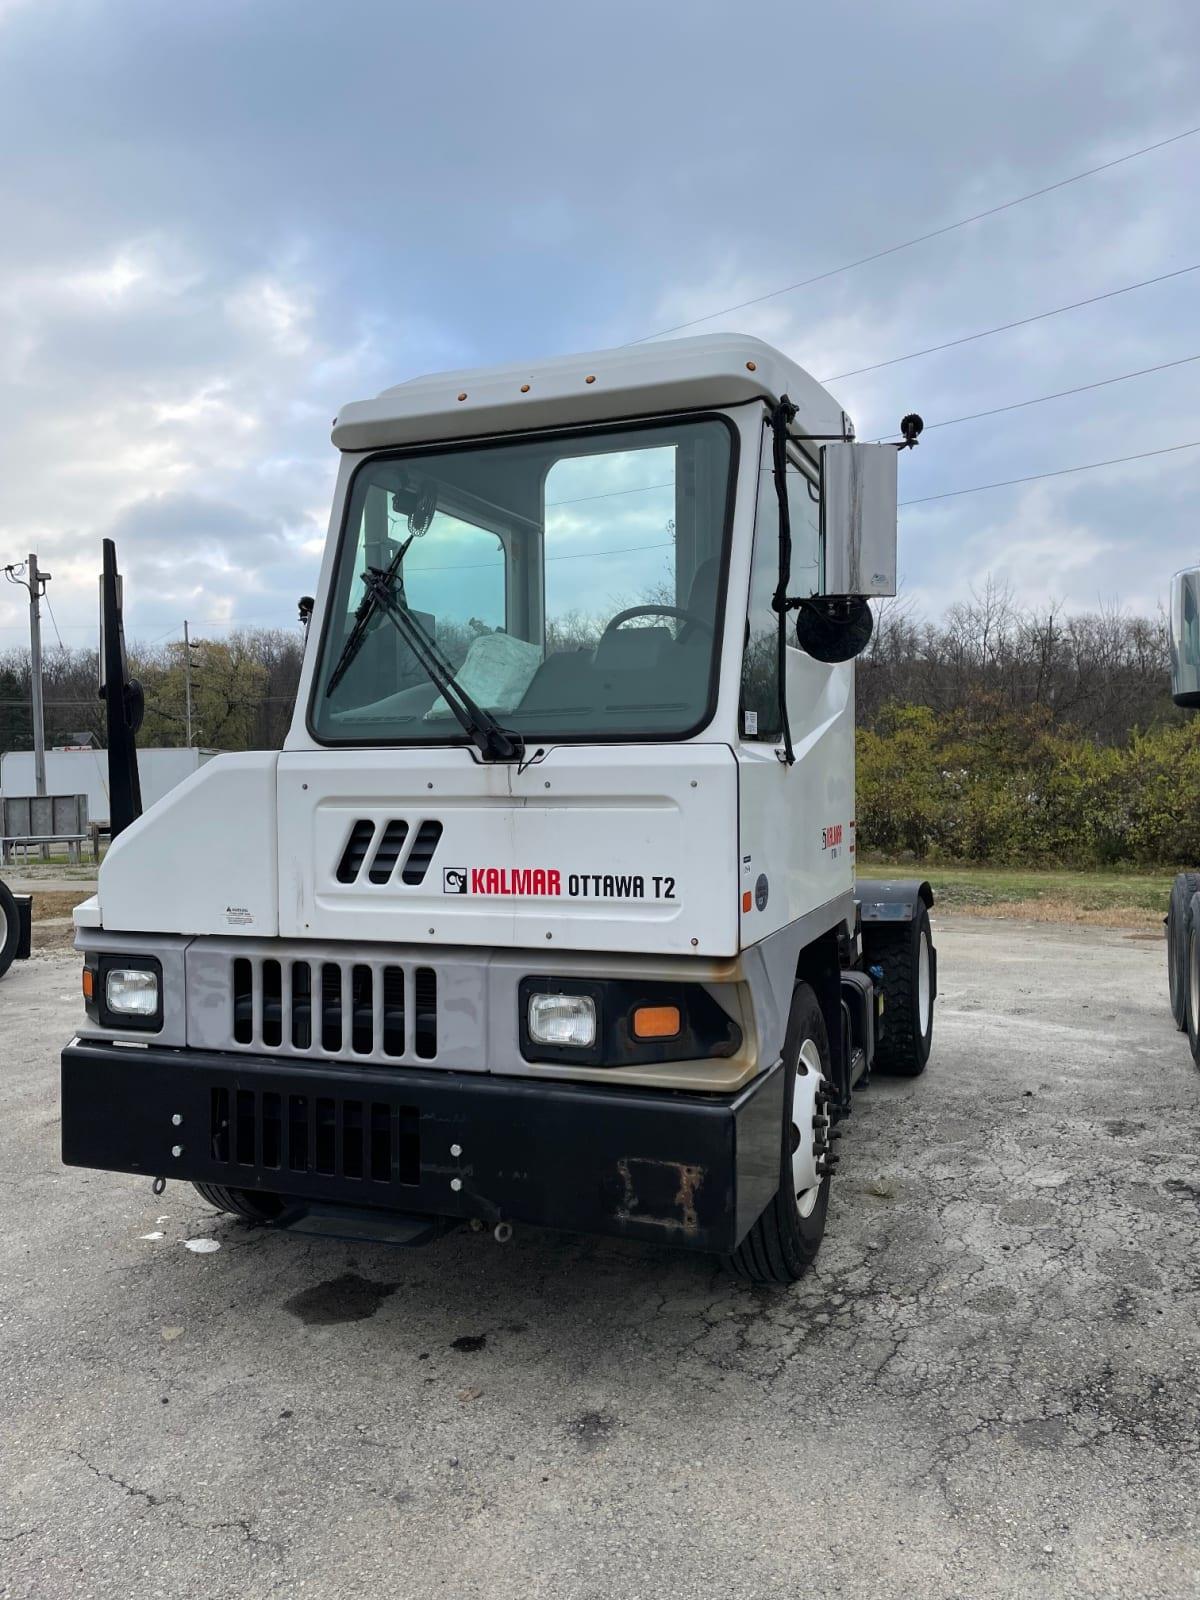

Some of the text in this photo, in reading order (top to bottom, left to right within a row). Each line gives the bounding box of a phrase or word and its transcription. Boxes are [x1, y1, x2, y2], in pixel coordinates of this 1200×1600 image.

[471, 868, 676, 899] KALMAR OTTAWA T2
